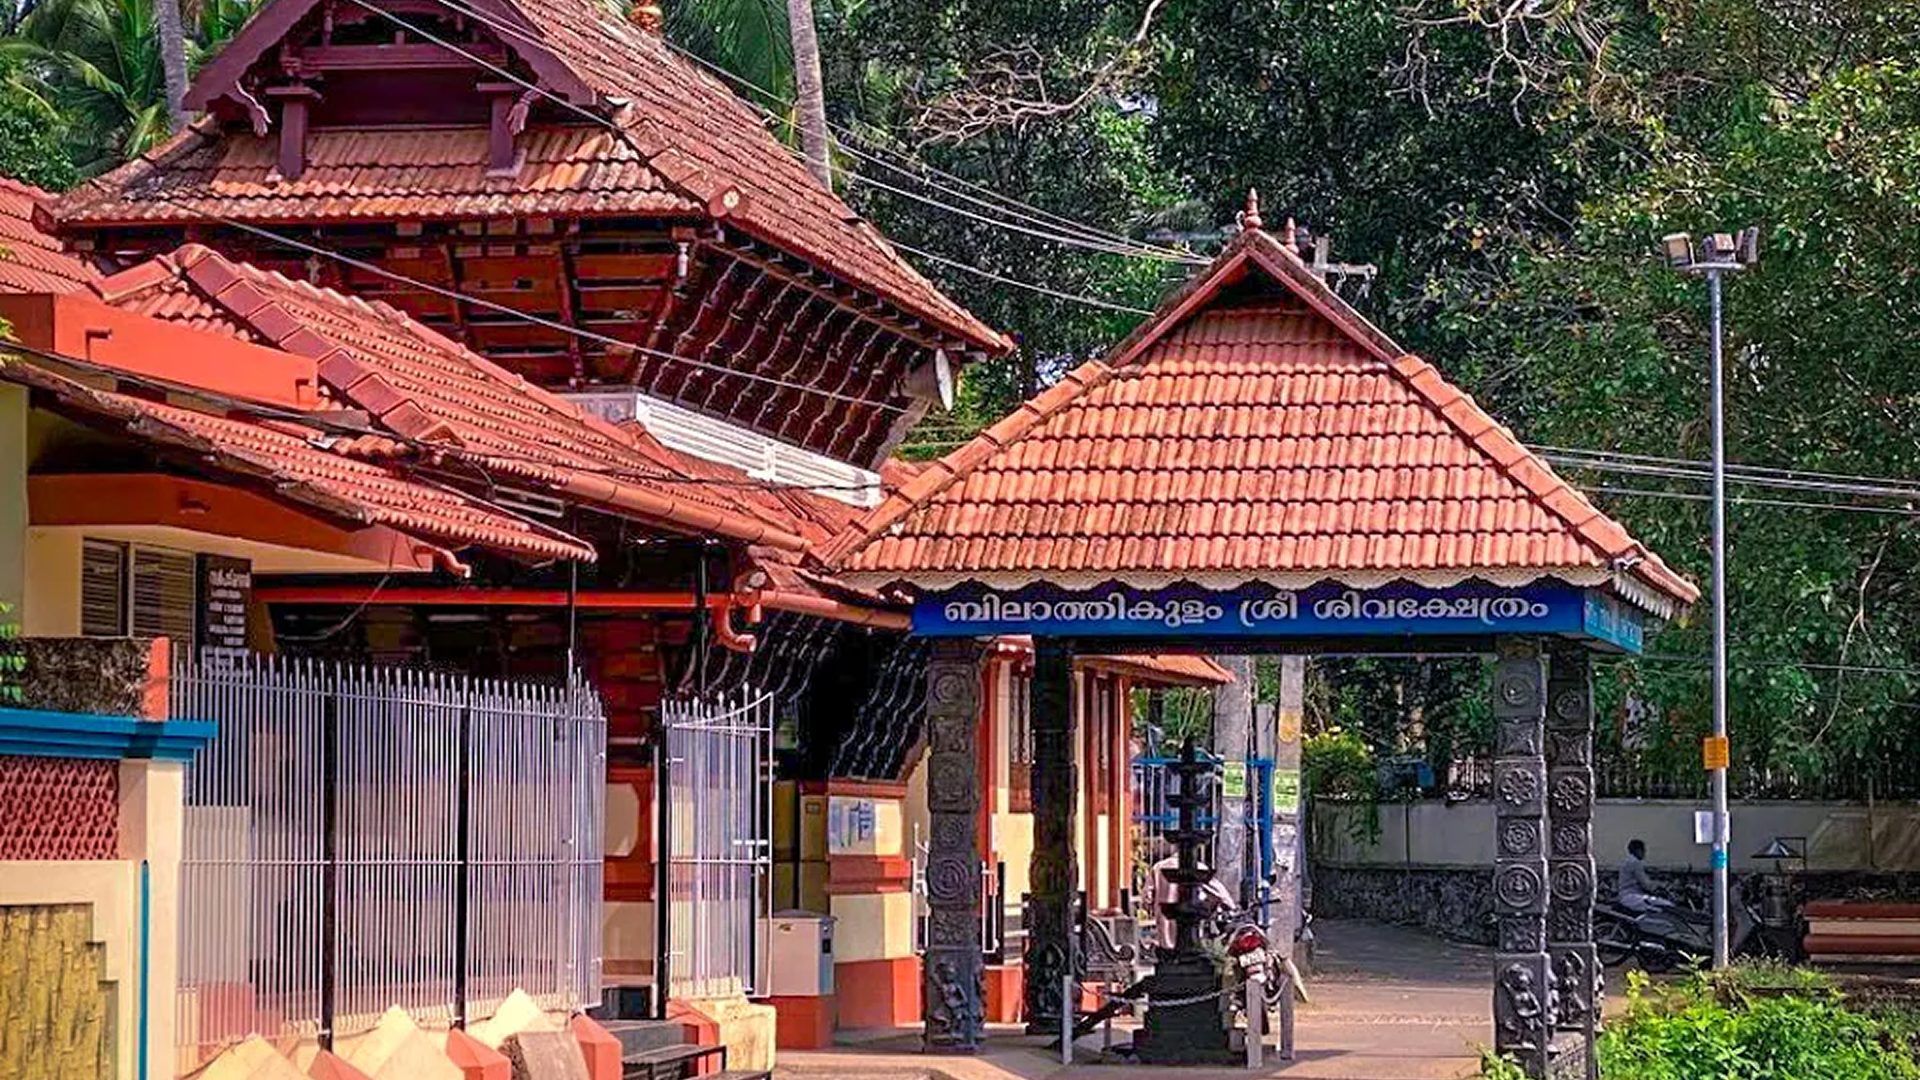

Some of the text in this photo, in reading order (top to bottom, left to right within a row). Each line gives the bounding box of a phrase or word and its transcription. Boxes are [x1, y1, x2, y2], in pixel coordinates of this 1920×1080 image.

[944, 593, 1224, 627] ബിലാത്തികുളം
[1239, 591, 1298, 627] ശ്രീ
[1313, 591, 1548, 624] ശിവക്ഷേത്രം
